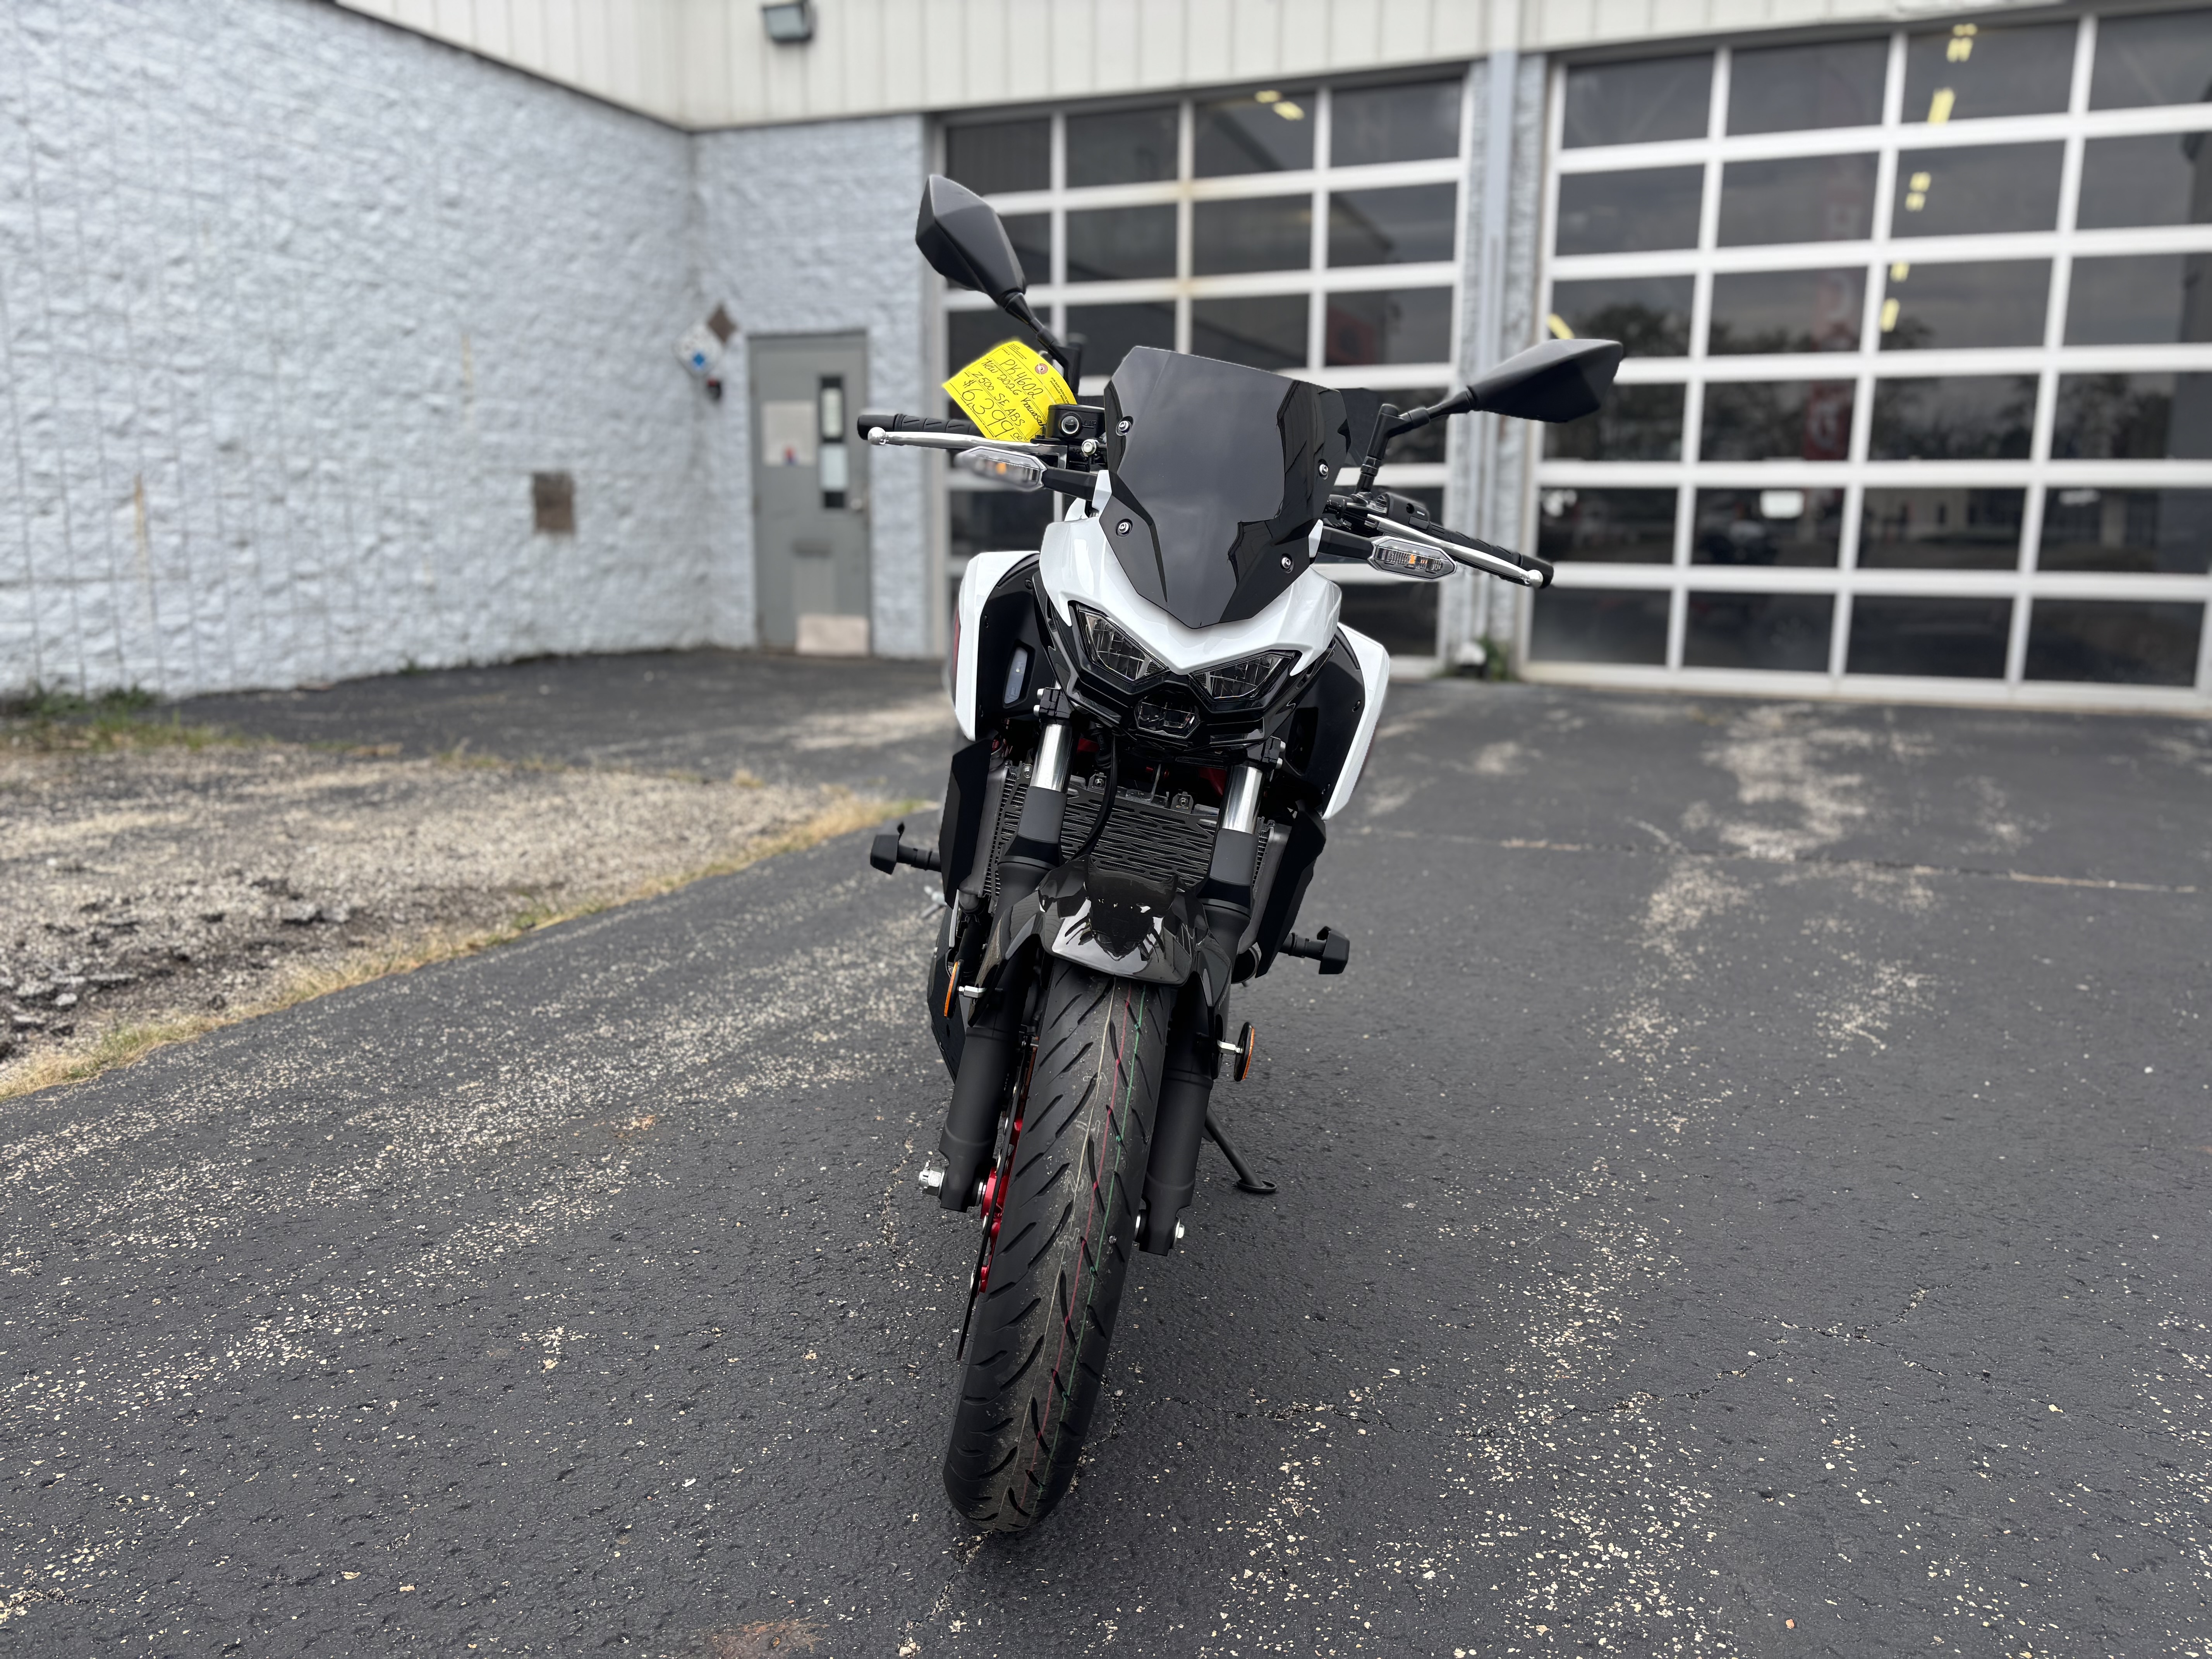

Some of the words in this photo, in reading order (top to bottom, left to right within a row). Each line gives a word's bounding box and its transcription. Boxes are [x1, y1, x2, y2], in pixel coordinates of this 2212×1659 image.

[971, 371, 994, 390] Z500
[994, 393, 1010, 406] SE
[1005, 409, 1025, 426] ABS
[981, 360, 999, 373] New
[997, 374, 1022, 395] 2026
